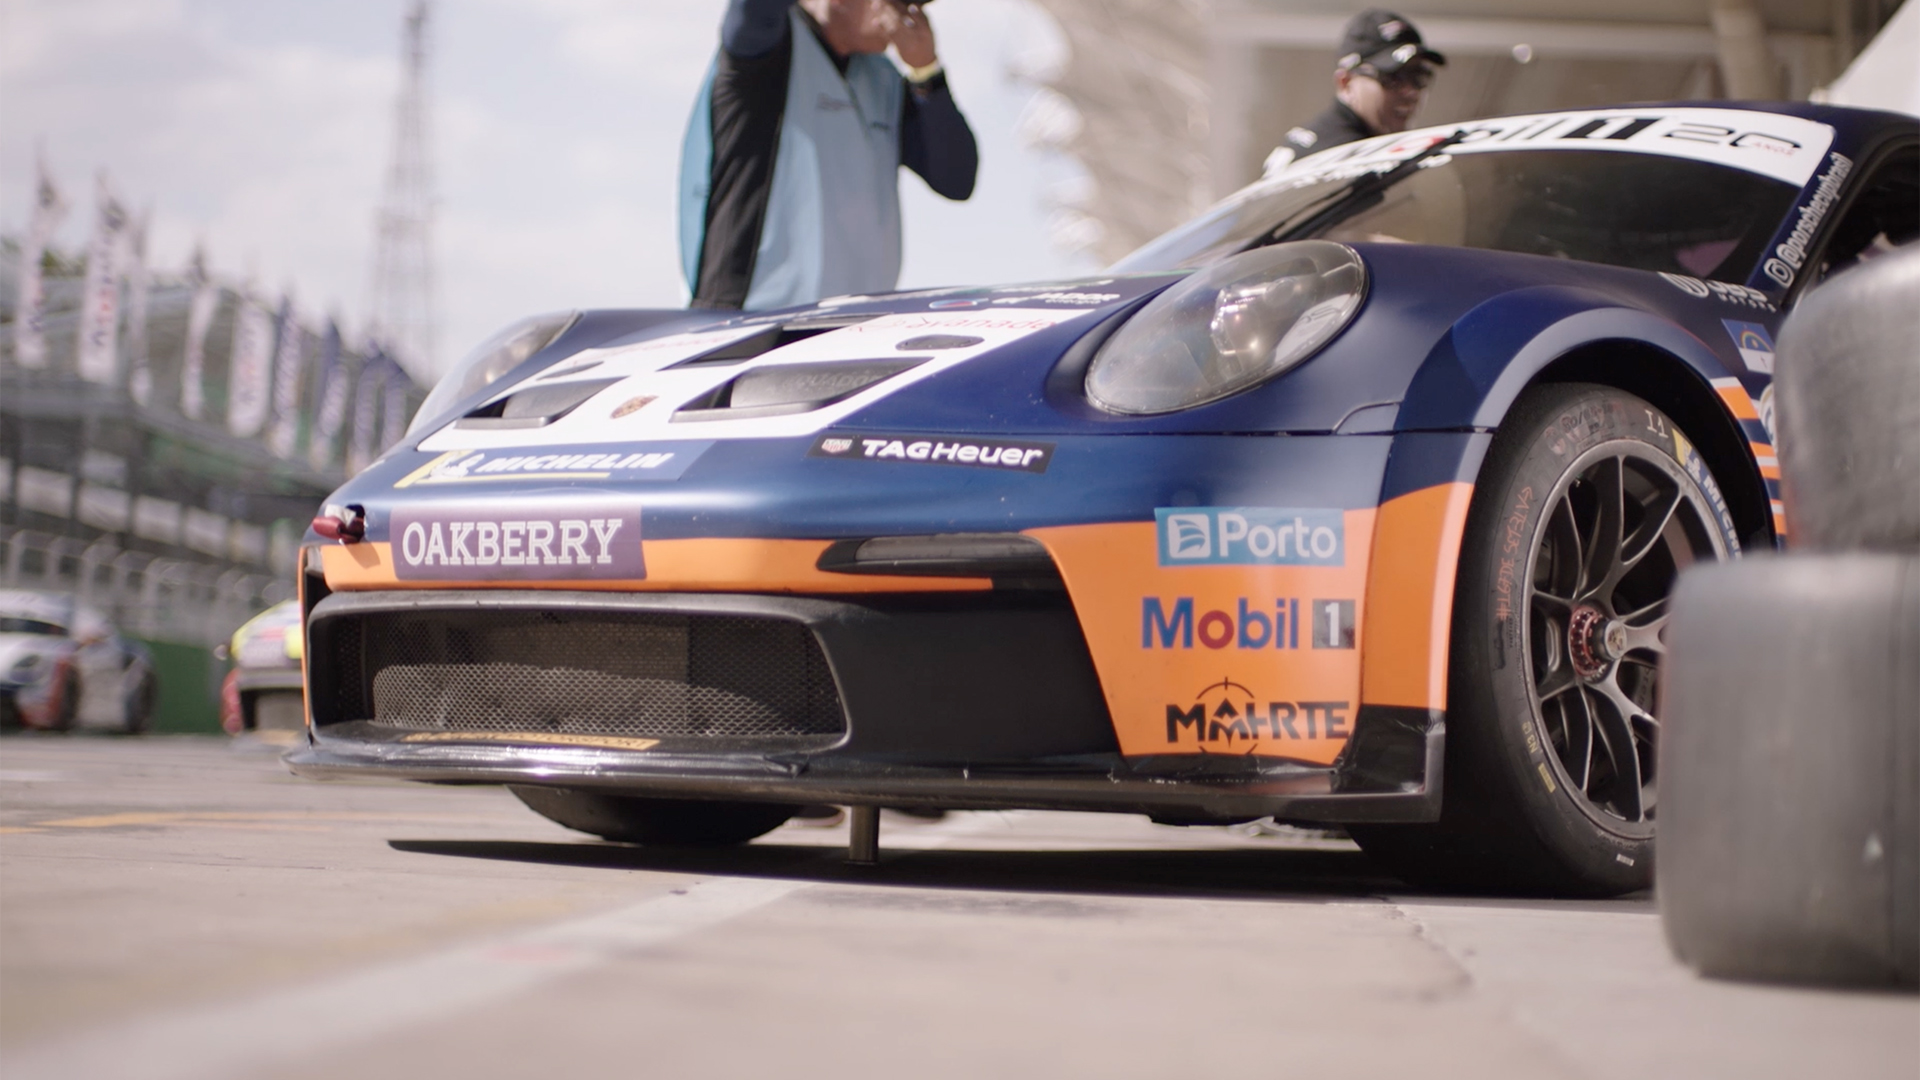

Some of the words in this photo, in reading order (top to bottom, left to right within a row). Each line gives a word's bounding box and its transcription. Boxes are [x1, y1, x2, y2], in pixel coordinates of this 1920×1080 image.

[1776, 151, 1854, 269] @porschecupbrasil
[474, 453, 675, 473] MICHELIN
[402, 518, 623, 566] OAKBERRY
[1217, 512, 1337, 558] Porto
[1142, 596, 1300, 650] Mobil
